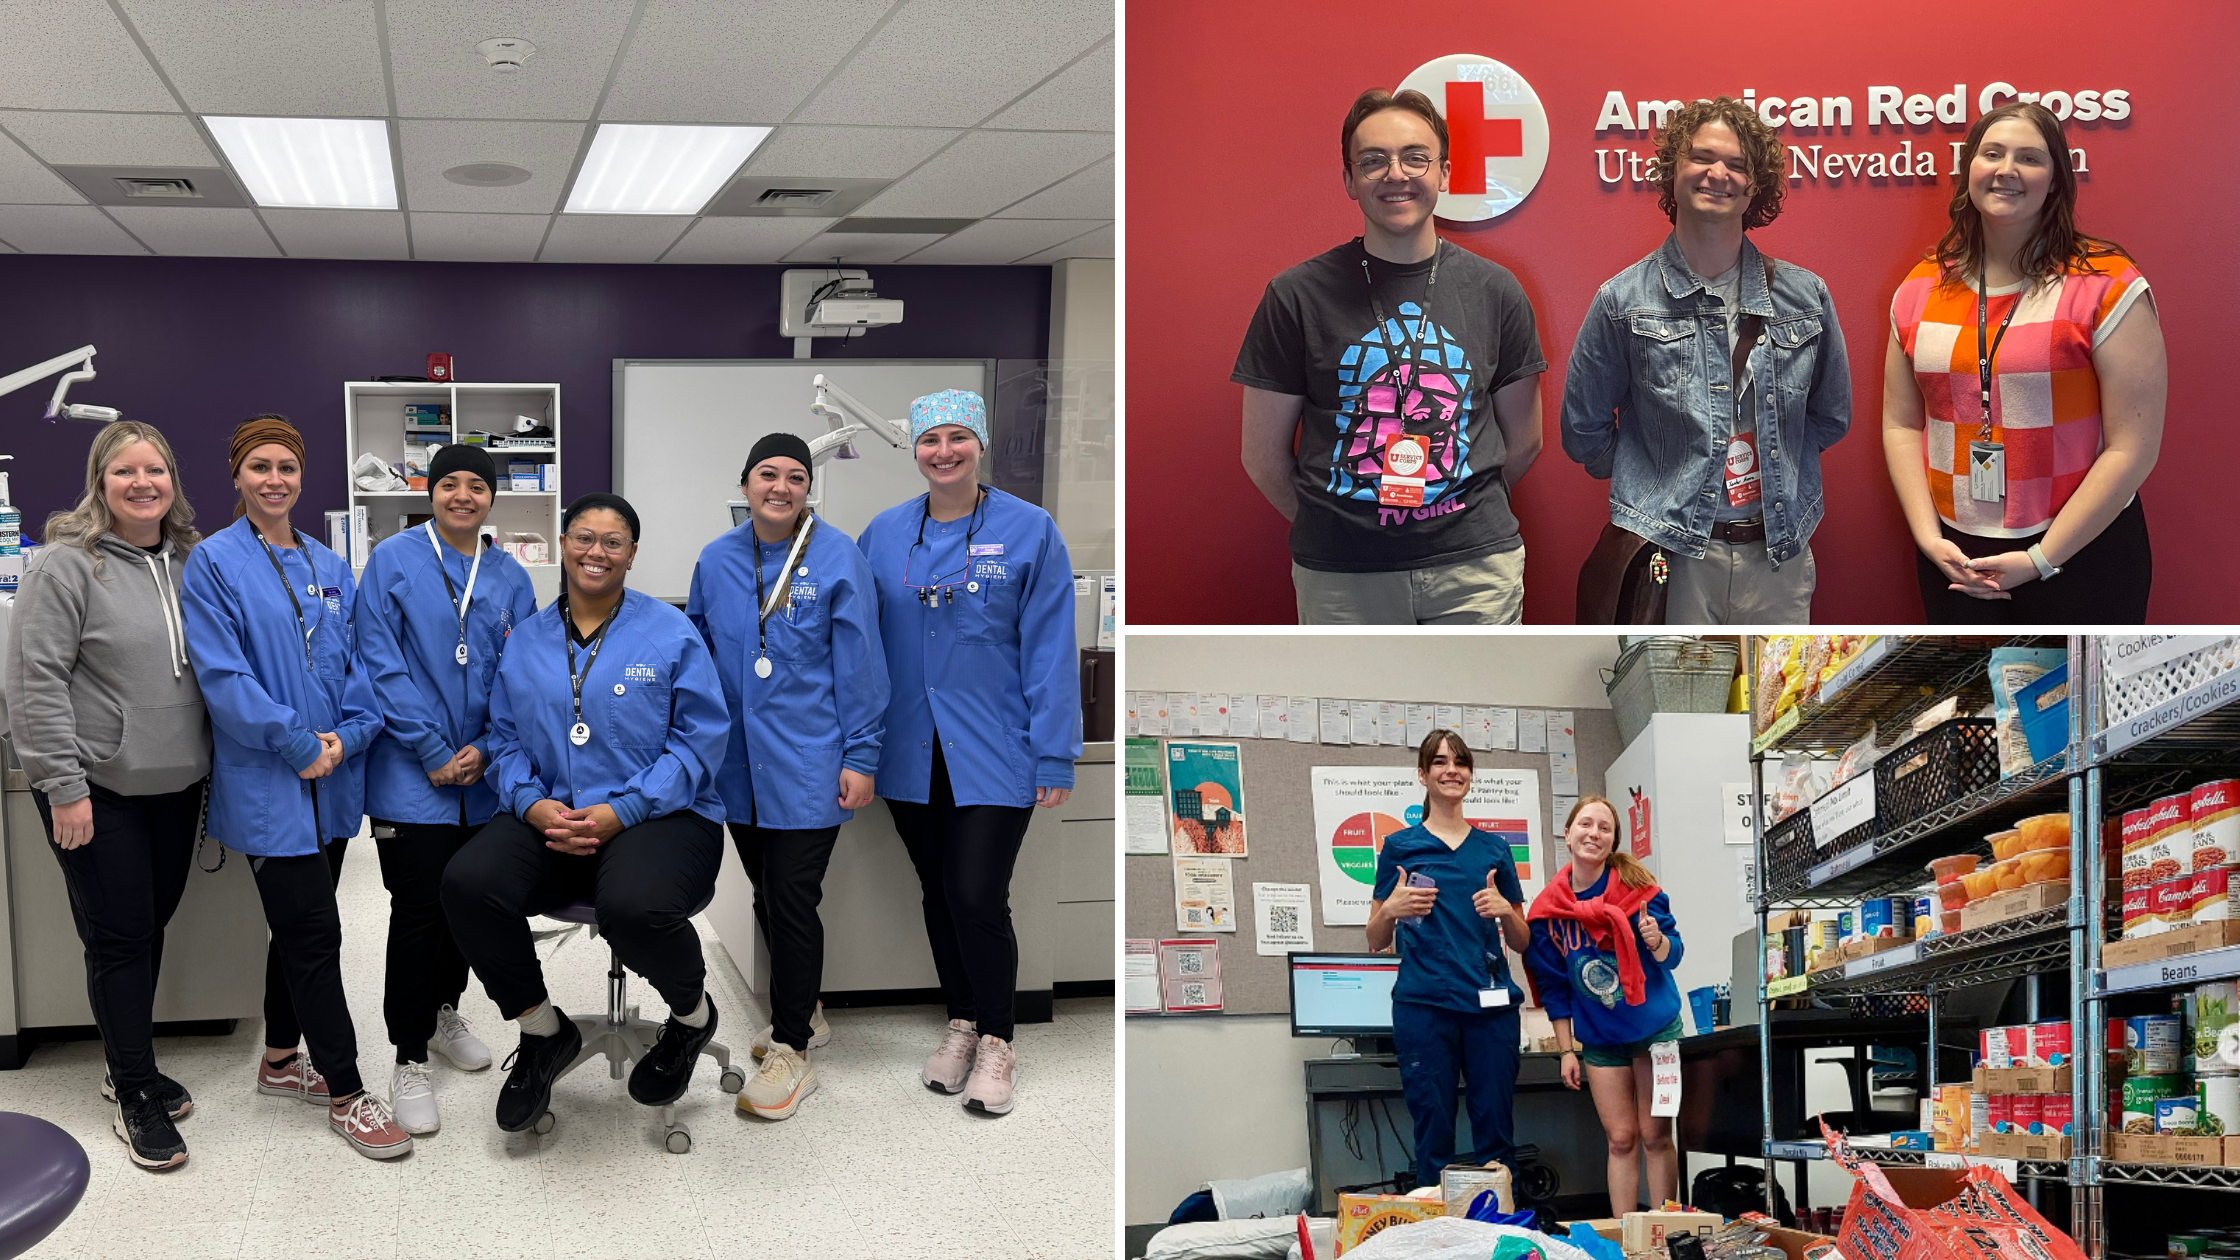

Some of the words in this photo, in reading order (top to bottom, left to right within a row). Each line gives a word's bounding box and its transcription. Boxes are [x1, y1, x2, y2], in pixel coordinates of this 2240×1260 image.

[1868, 84, 1967, 126] Red
[1595, 149, 1662, 184] Uta
[1788, 145, 1938, 181] Nevada
[1378, 507, 1409, 526] TV
[1411, 497, 1467, 521] GIRL
[976, 565, 1006, 576] DENTAL
[975, 574, 1006, 582] HYGIENE
[790, 585, 817, 596] DENTAL
[2117, 635, 2164, 658] Cookies
[625, 667, 656, 677] DENTAL
[2130, 679, 2237, 737] Crackers/Cookies
[1323, 778, 1340, 786] This
[1392, 779, 1414, 788] plate
[1478, 787, 1503, 796] Pantry
[1505, 788, 1519, 796] bag
[1478, 821, 1499, 829] FRUIT
[1343, 828, 1365, 837] FRUIT
[1336, 898, 1359, 906] Please
[1872, 957, 1885, 969] Fruit
[2161, 964, 2198, 982] Beans
[2203, 1026, 2239, 1039] Beans
[2135, 1095, 2159, 1105] green
[1873, 1195, 1910, 1241] Maruchan
[1871, 1215, 1899, 1253] Ramen
